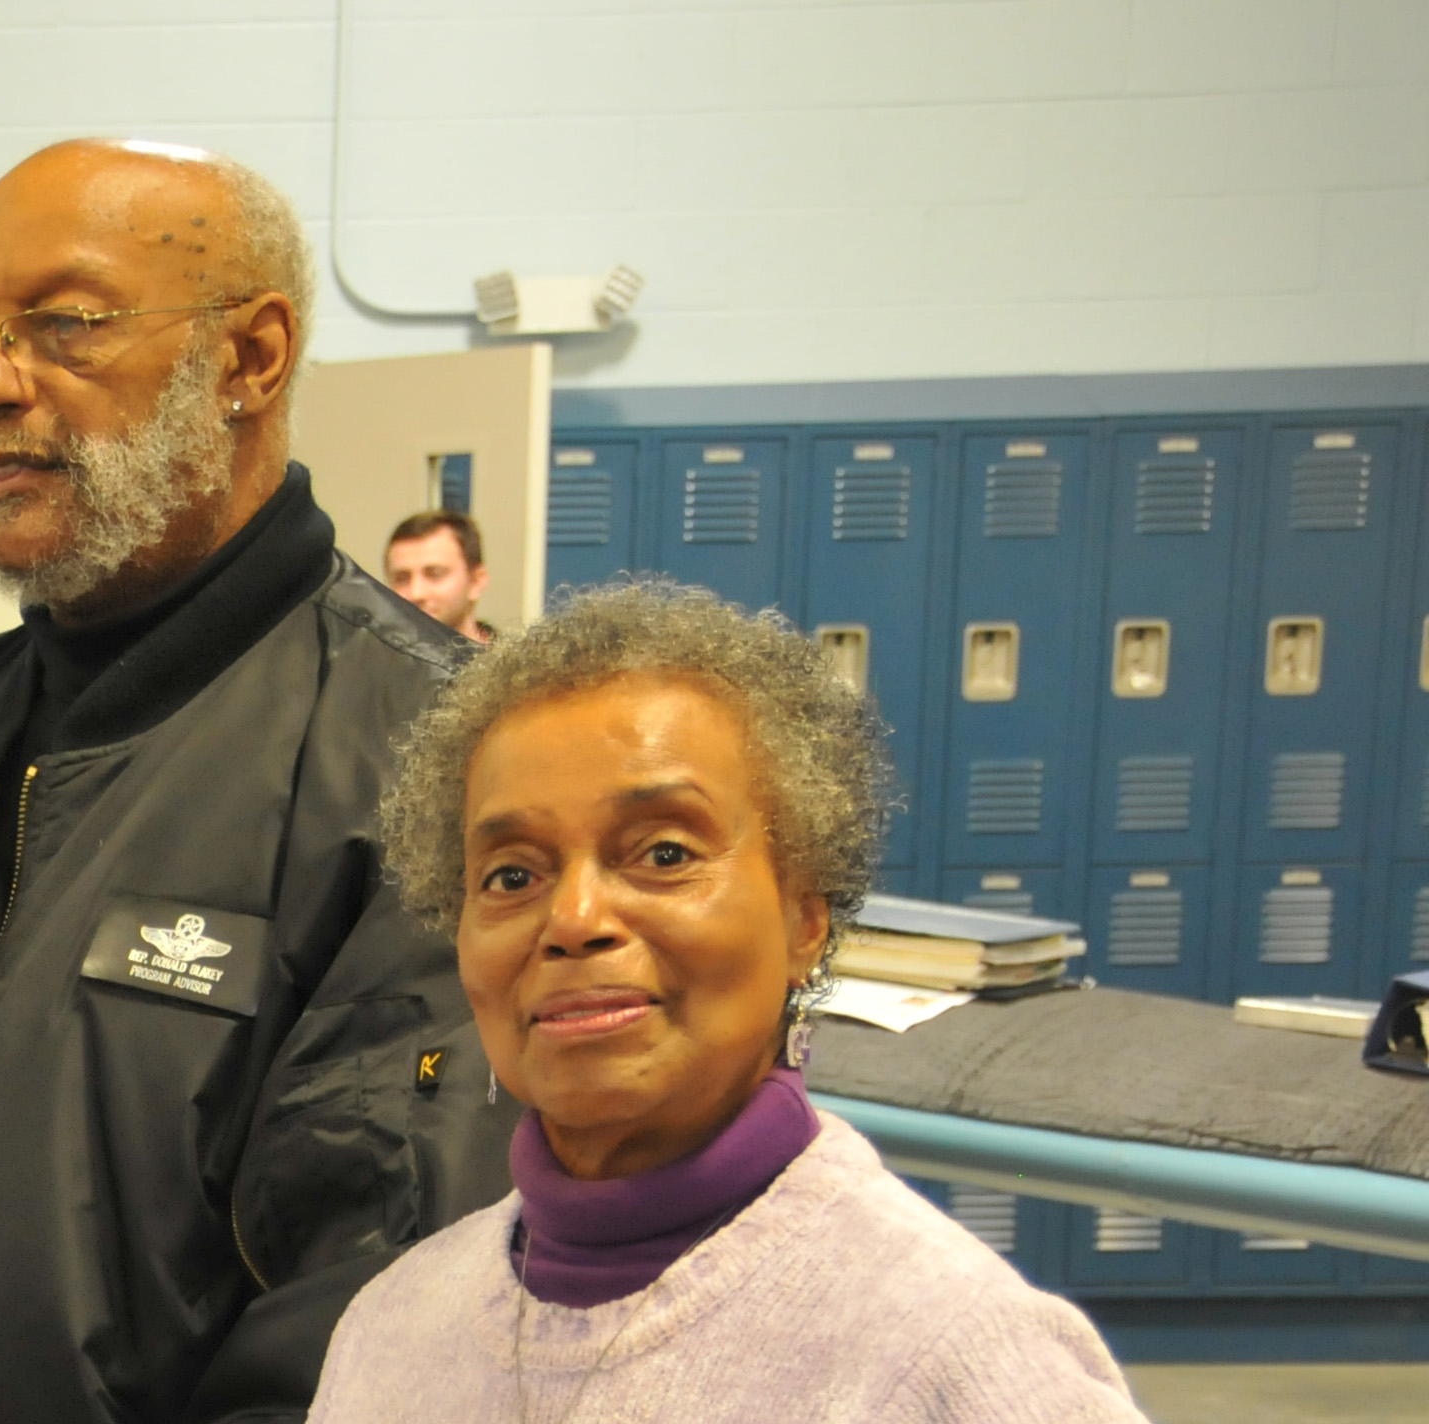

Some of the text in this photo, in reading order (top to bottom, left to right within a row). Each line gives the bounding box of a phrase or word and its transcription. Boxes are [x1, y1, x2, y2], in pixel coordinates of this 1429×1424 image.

[129, 965, 213, 995] PROGRAM ADVISOR
[151, 954, 188, 973] DONALD
[190, 963, 224, 982] BLAKEY
